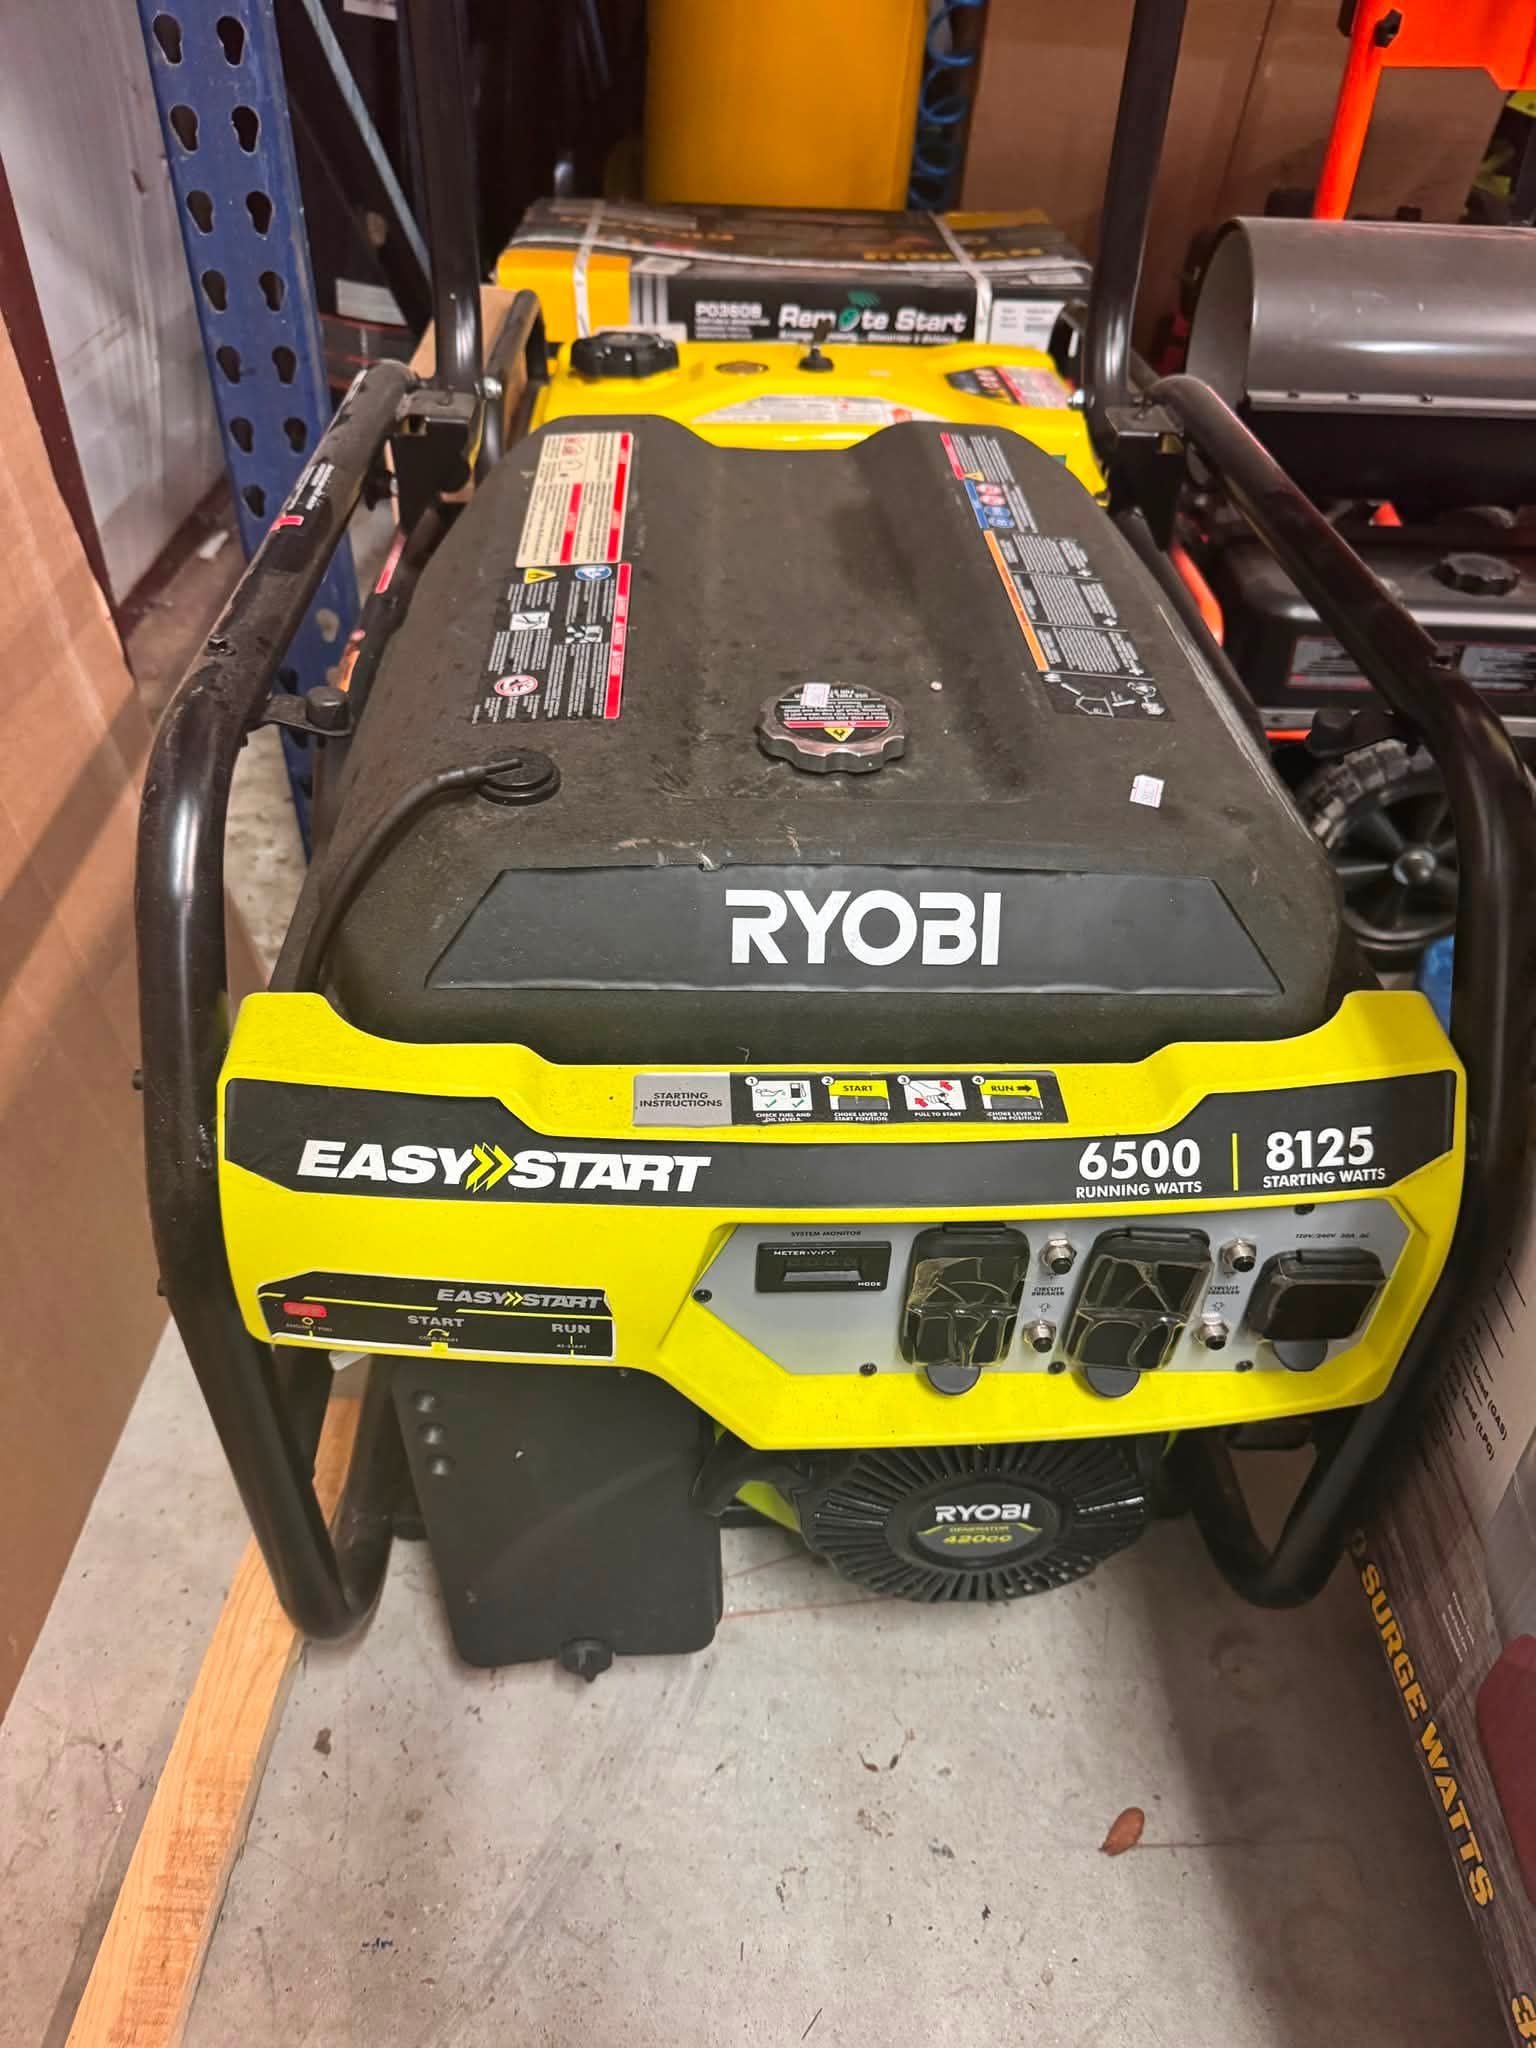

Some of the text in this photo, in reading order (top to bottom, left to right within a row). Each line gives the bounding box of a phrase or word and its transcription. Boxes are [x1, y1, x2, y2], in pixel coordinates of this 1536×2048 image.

[894, 306, 967, 333] Start
[725, 889, 1002, 966] RYOBI
[639, 1099, 723, 1108] INSTRUCTIONS
[653, 1092, 709, 1100] STARTING
[1078, 1138, 1201, 1181] 6500
[1265, 1126, 1375, 1172] 8125
[297, 1139, 712, 1193] EASY START
[1262, 1168, 1386, 1189] STARTING WATTS
[1076, 1181, 1203, 1199] RUNNING WATTS
[437, 1288, 603, 1309] EASY START
[407, 1315, 465, 1328] START
[551, 1323, 591, 1334] RUN
[1476, 1422, 1494, 1461] (LPG)
[935, 1503, 1031, 1523] RYOBI
[1361, 1562, 1428, 1721] SURGE
[1420, 1719, 1494, 1906] WATTS
